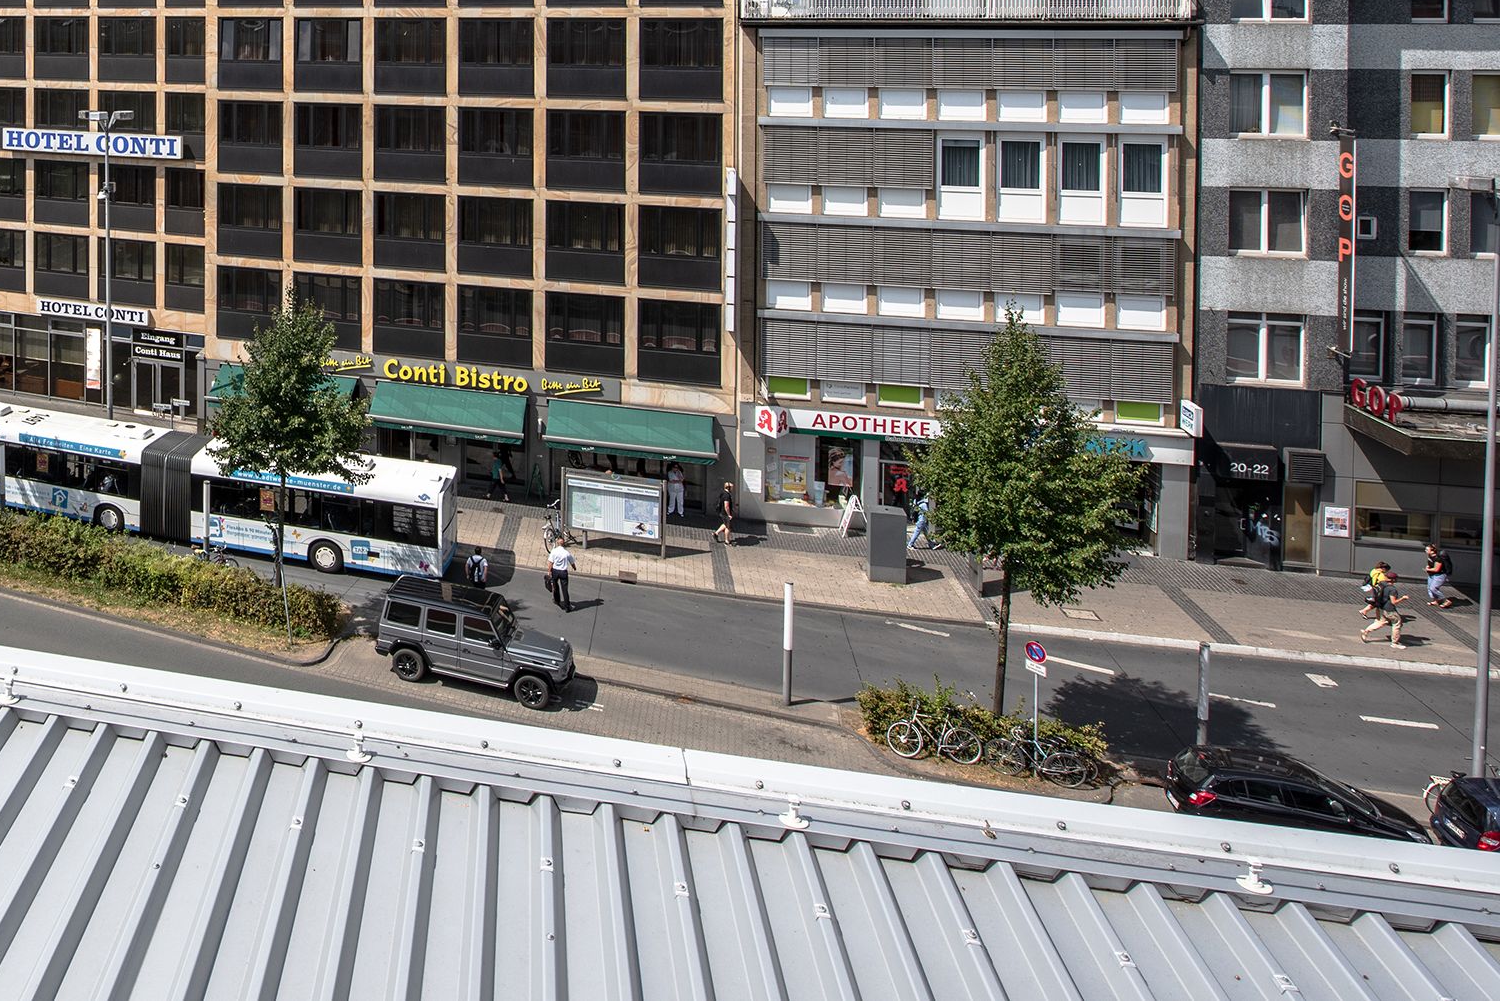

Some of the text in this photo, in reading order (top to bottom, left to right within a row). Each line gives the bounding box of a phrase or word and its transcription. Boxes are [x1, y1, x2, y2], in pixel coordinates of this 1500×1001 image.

[6, 130, 177, 156] HOTEL CONTI
[40, 300, 145, 323] HOTEL CONTI
[141, 332, 175, 345] Eingang
[135, 346, 181, 359] Conti Haus
[383, 358, 528, 393] Conti Bistro
[566, 381, 581, 389] ein
[1351, 377, 1403, 424] GOP
[811, 413, 931, 437] APOTHEKE
[1230, 462, 1269, 475] 20-22
